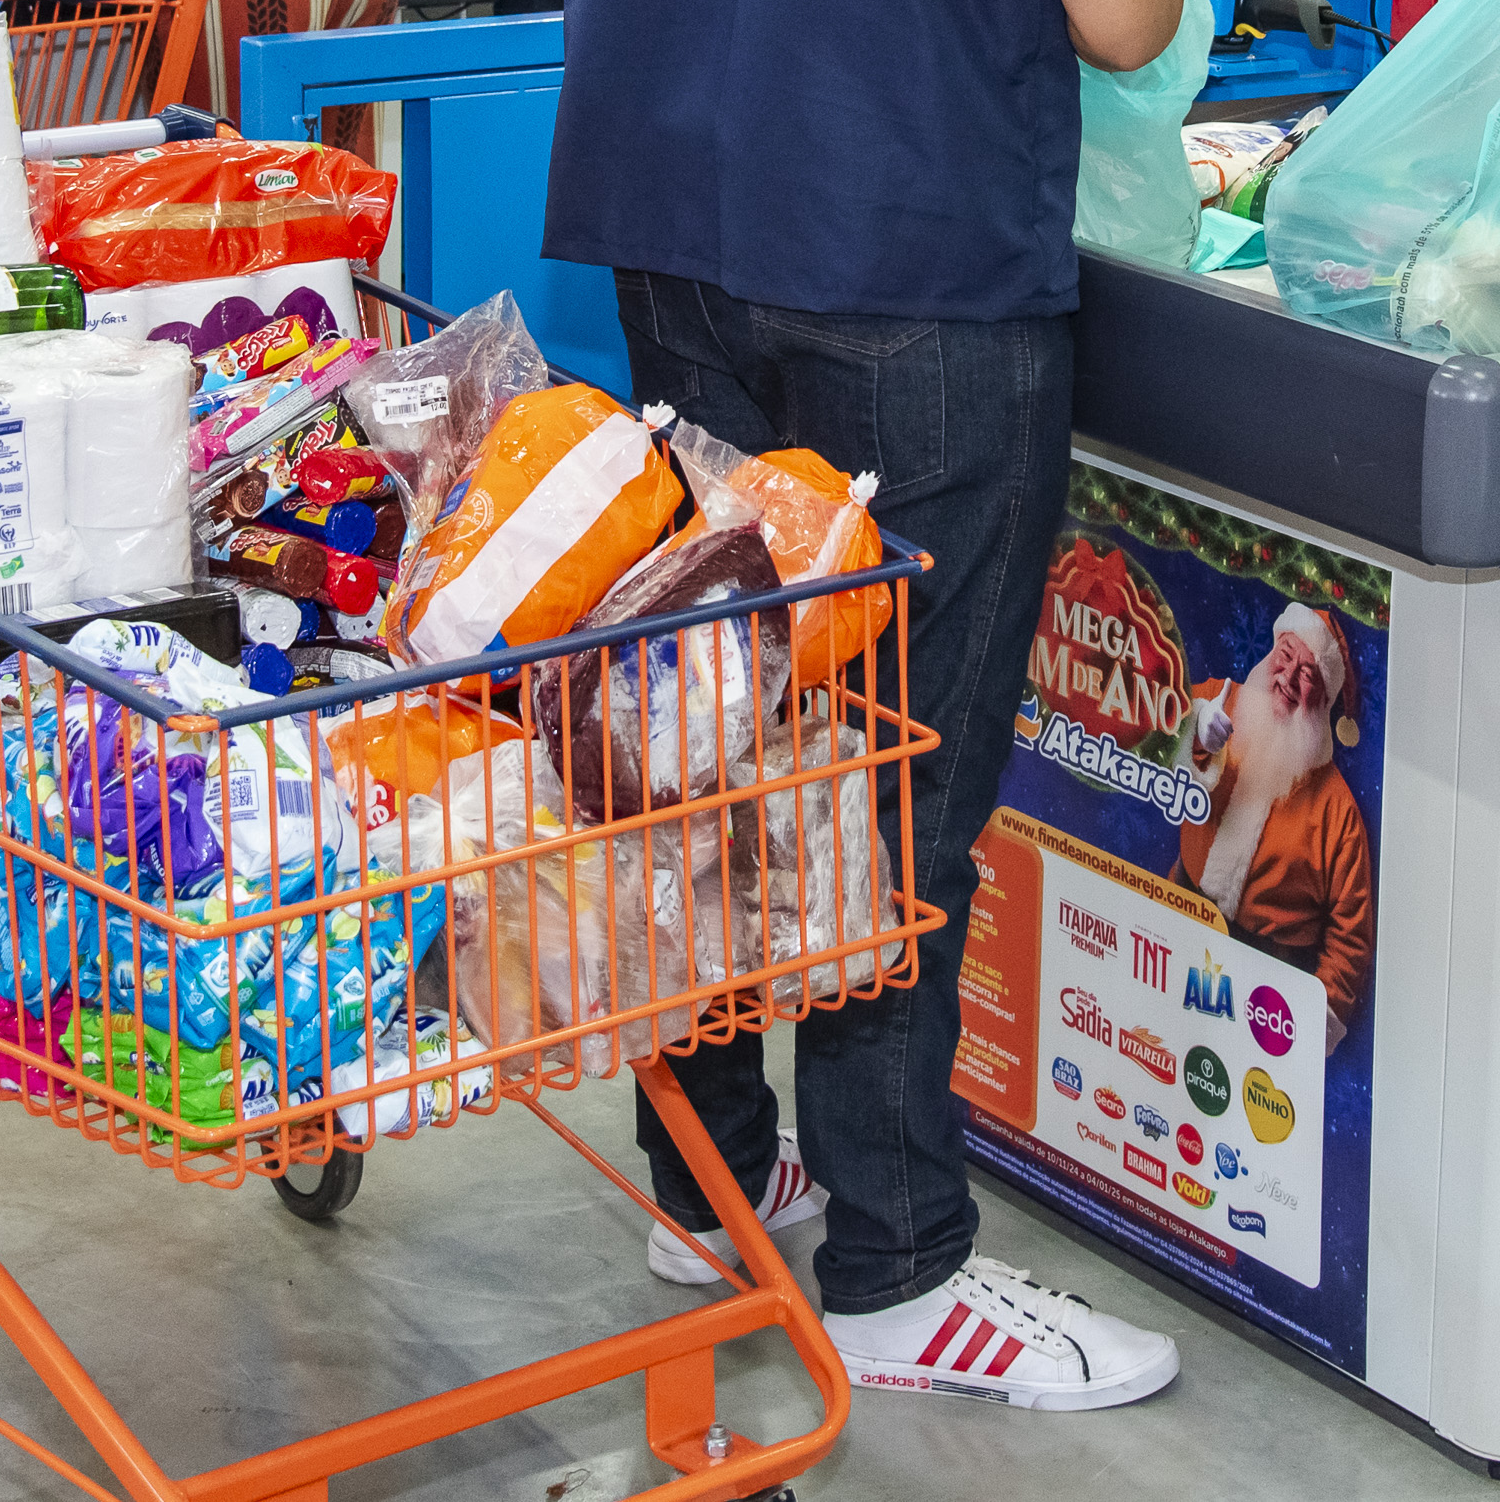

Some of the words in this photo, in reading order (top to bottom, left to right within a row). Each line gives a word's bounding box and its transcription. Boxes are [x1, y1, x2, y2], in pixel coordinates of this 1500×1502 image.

[1, 506, 22, 517] Terra
[129, 624, 162, 647] ALA
[1052, 592, 1144, 670] MEGA
[1072, 661, 1103, 699] DE
[1100, 661, 1182, 737] ANO
[1041, 713, 1211, 825] Atakarejo
[1000, 811, 1218, 926] www.fimdeanoatakarejo.com.br
[970, 930, 986, 943] site.
[980, 919, 998, 937] nota
[1059, 900, 1119, 952] ITAIPAVA
[1070, 932, 1105, 961] PREMIUM
[1129, 930, 1173, 994] TNT
[969, 969, 1003, 993] presente
[985, 964, 1002, 980] saco
[958, 986, 1016, 1024] vales-compras!
[1076, 996, 1091, 1008] pede
[1077, 985, 1088, 998] Seu
[1088, 992, 1097, 1003] dia
[1183, 966, 1236, 1022] ALA
[1060, 987, 1113, 1048] Sadia
[1244, 999, 1297, 1043] seda
[965, 1053, 993, 1075] marcas
[969, 1031, 987, 1048] mais
[989, 1042, 1021, 1066] chances
[973, 1044, 1009, 1072] produtos
[1120, 1034, 1175, 1075] VITARELLA
[954, 1059, 1007, 1095] participantes!
[1054, 1067, 1080, 1089] BRAZ
[1058, 1058, 1076, 1076] SÃO
[1186, 1070, 1228, 1100] piraquê
[1095, 1090, 1125, 1117] Seara
[1246, 1086, 1289, 1120] NINHO
[1135, 1104, 1169, 1136] FOFURA
[1177, 1132, 1202, 1156] Coca-Cola
[1126, 1150, 1164, 1184] BRAHMA
[975, 1110, 1014, 1140] Campanha
[1014, 1133, 1036, 1152] válida
[1036, 1144, 1046, 1158] de
[1047, 1151, 1080, 1177] 10/11/24
[1086, 1173, 1121, 1200] 04/01/25
[1122, 1195, 1135, 1208] em
[1137, 1199, 1158, 1221] todas
[1159, 1214, 1169, 1225] as
[1169, 1219, 1188, 1239] lojas
[1188, 1229, 1229, 1261] Atakarejo.
[1174, 1172, 1207, 1205] Yoki
[1255, 1171, 1299, 1211] Neve
[1231, 1211, 1264, 1229] ekobom
[859, 1371, 916, 1388] adidas
